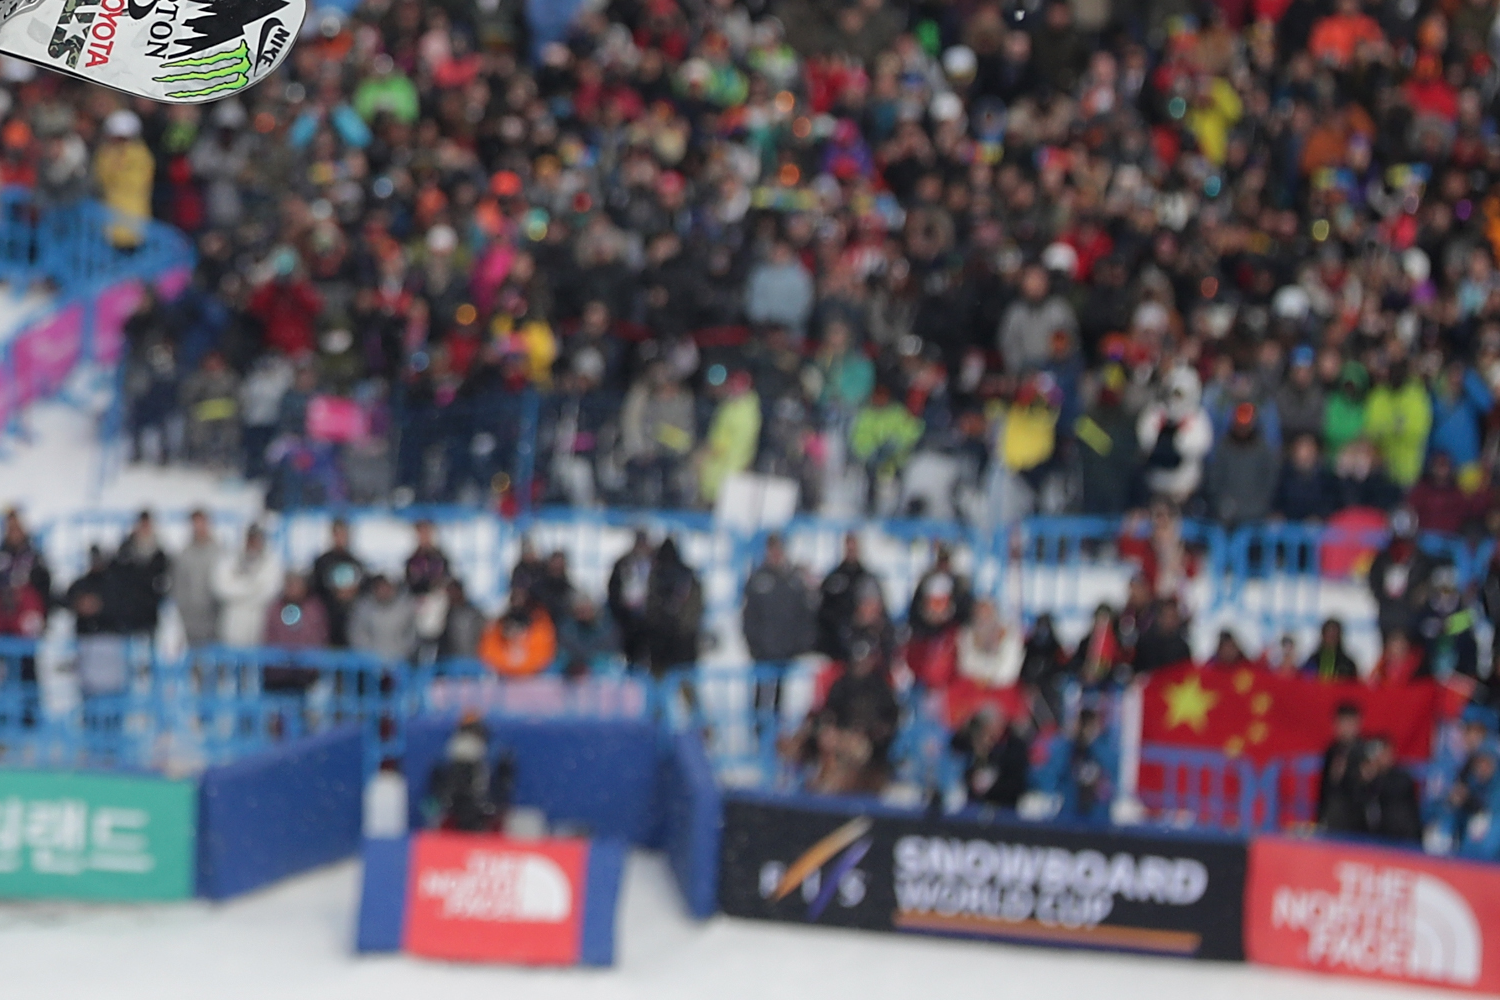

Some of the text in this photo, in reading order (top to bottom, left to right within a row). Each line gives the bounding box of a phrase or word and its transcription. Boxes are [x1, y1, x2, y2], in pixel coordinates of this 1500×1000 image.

[258, 27, 291, 68] NIKE
[894, 835, 1210, 906] SNOWBOARD
[1335, 860, 1414, 904] THE
[896, 879, 1115, 929] WORLD CUP
[1271, 885, 1414, 940] NORTH
[1306, 927, 1414, 975] FACE
